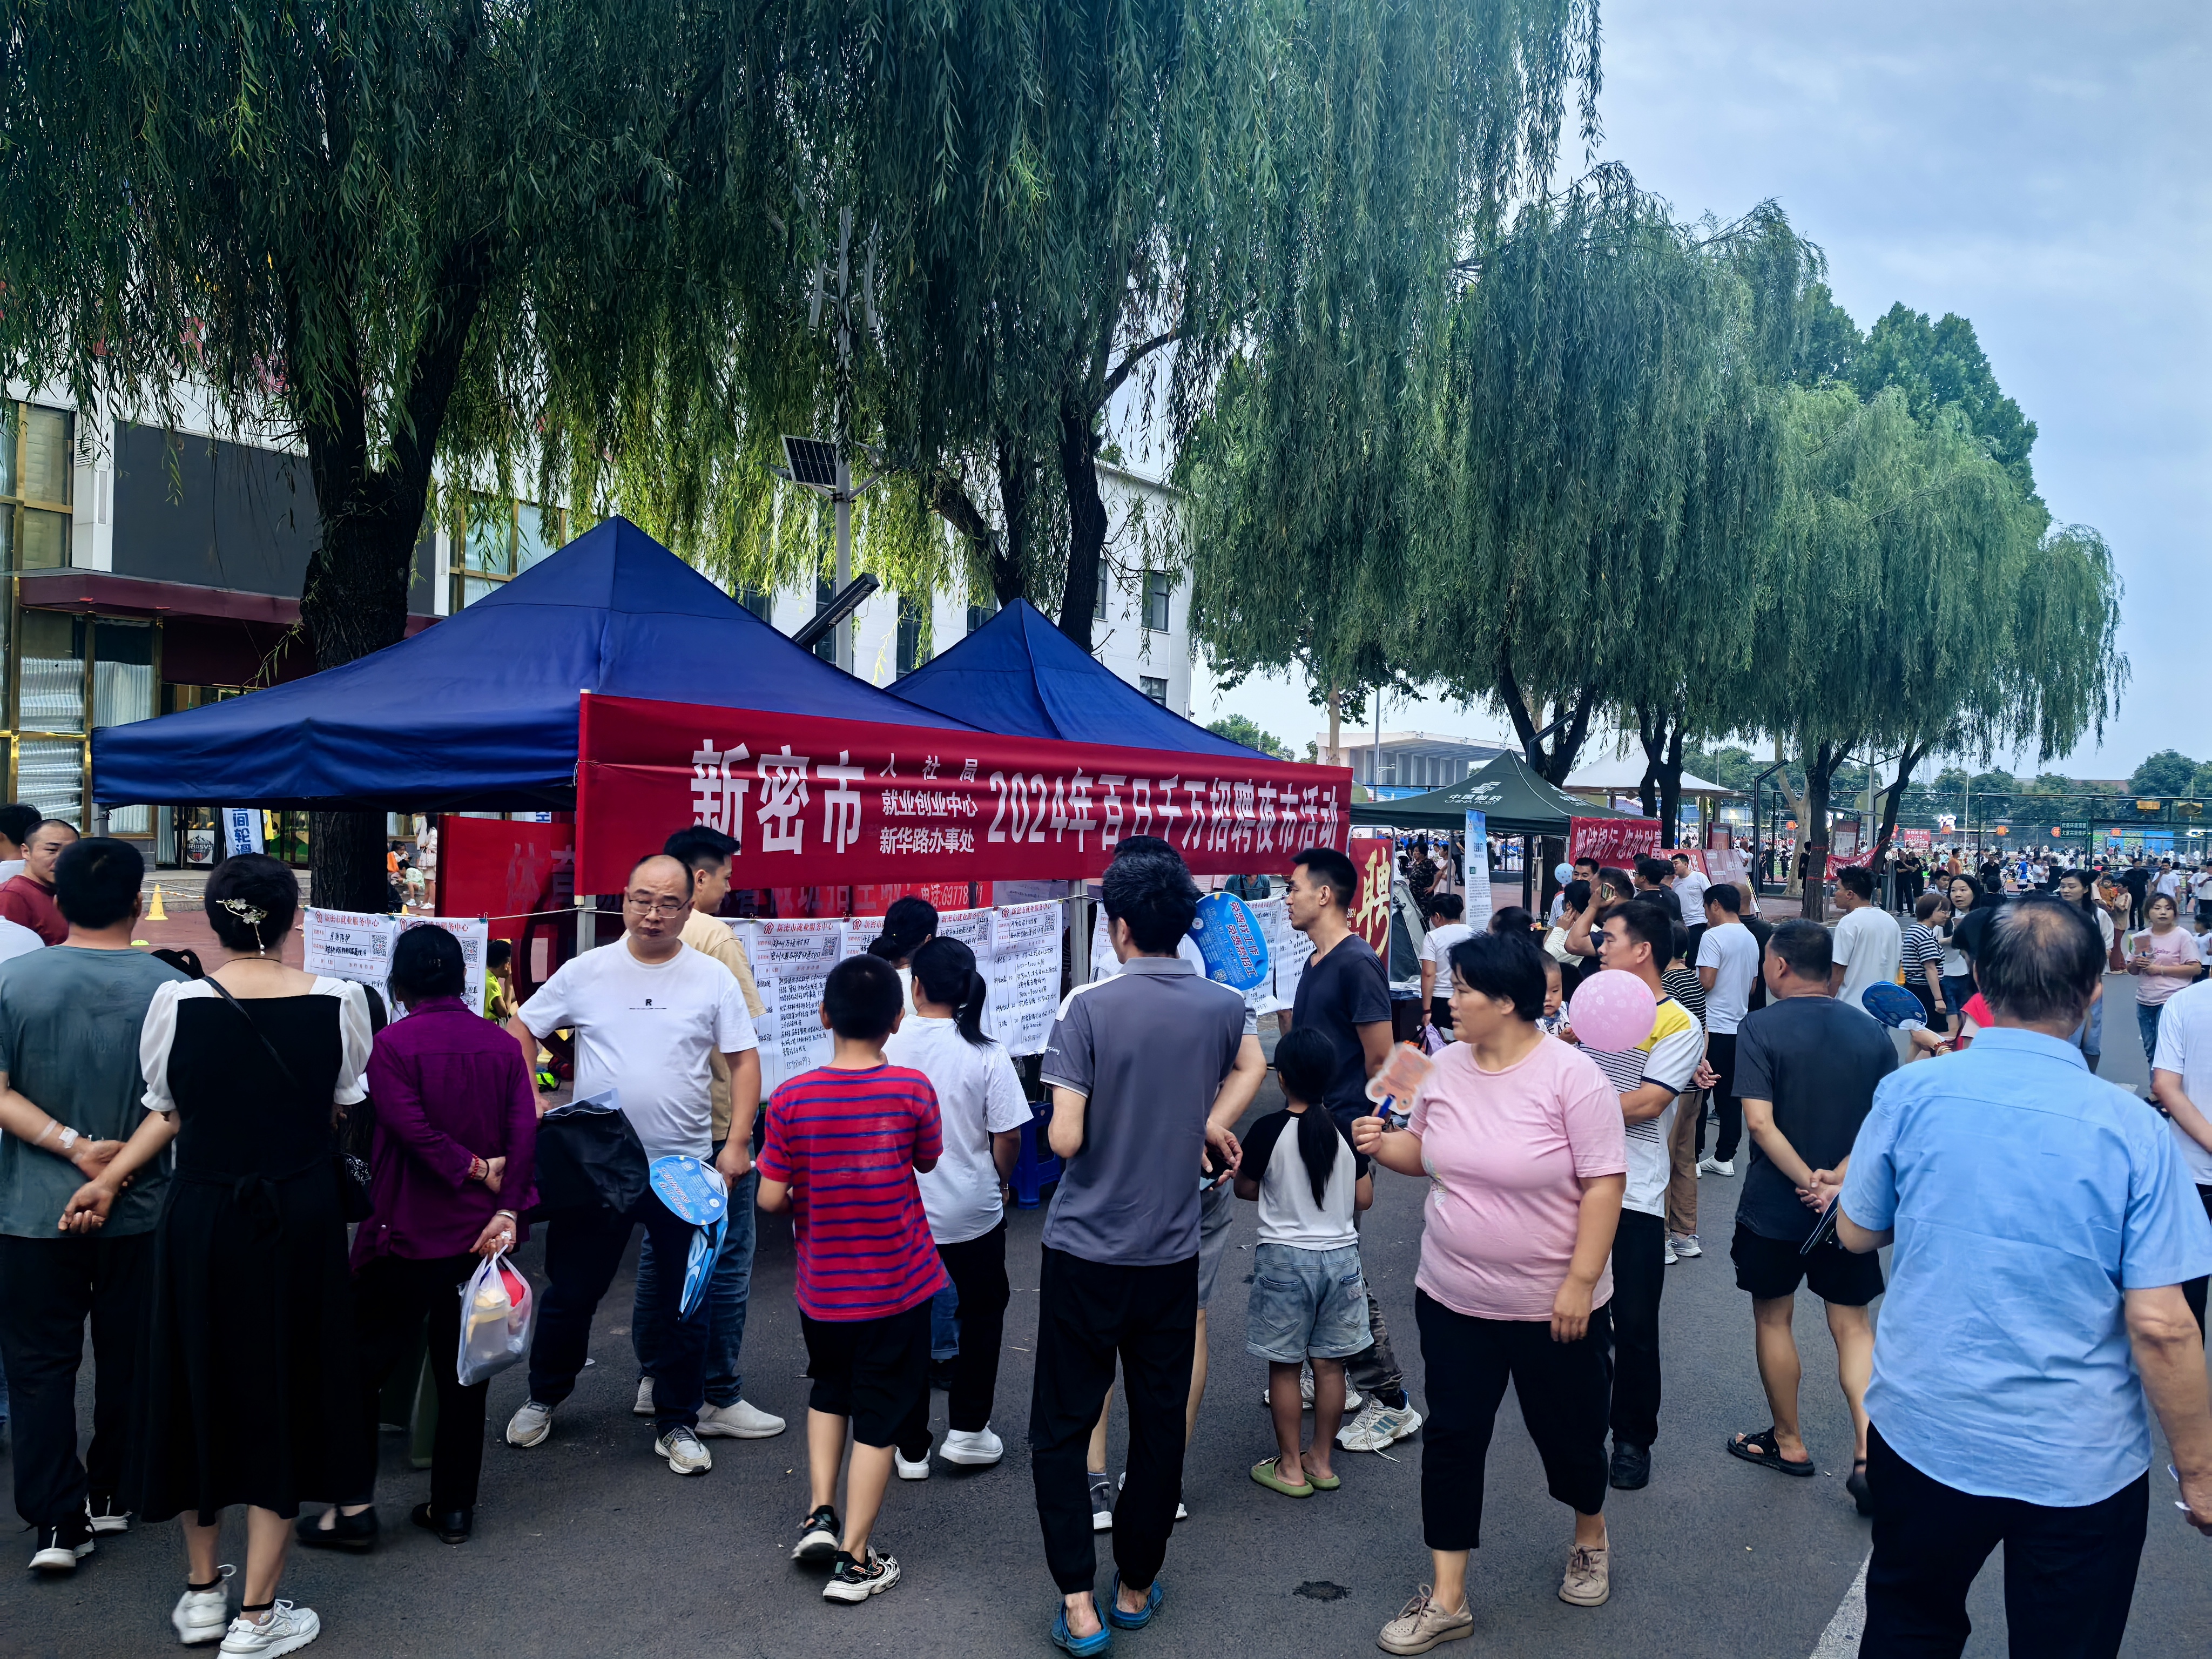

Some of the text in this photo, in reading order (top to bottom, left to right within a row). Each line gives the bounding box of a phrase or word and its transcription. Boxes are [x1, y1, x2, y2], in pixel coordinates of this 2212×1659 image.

[880, 752, 977, 783] 人社局
[691, 738, 866, 855] 新密市
[881, 788, 979, 819] 就业创业中心
[988, 766, 1339, 854] 2024年百日千万招聘夜市活动
[879, 827, 975, 855] 新华路办事处
[921, 884, 983, 909] 电话:6977811
[777, 922, 833, 933] 新密市就业服务中心
